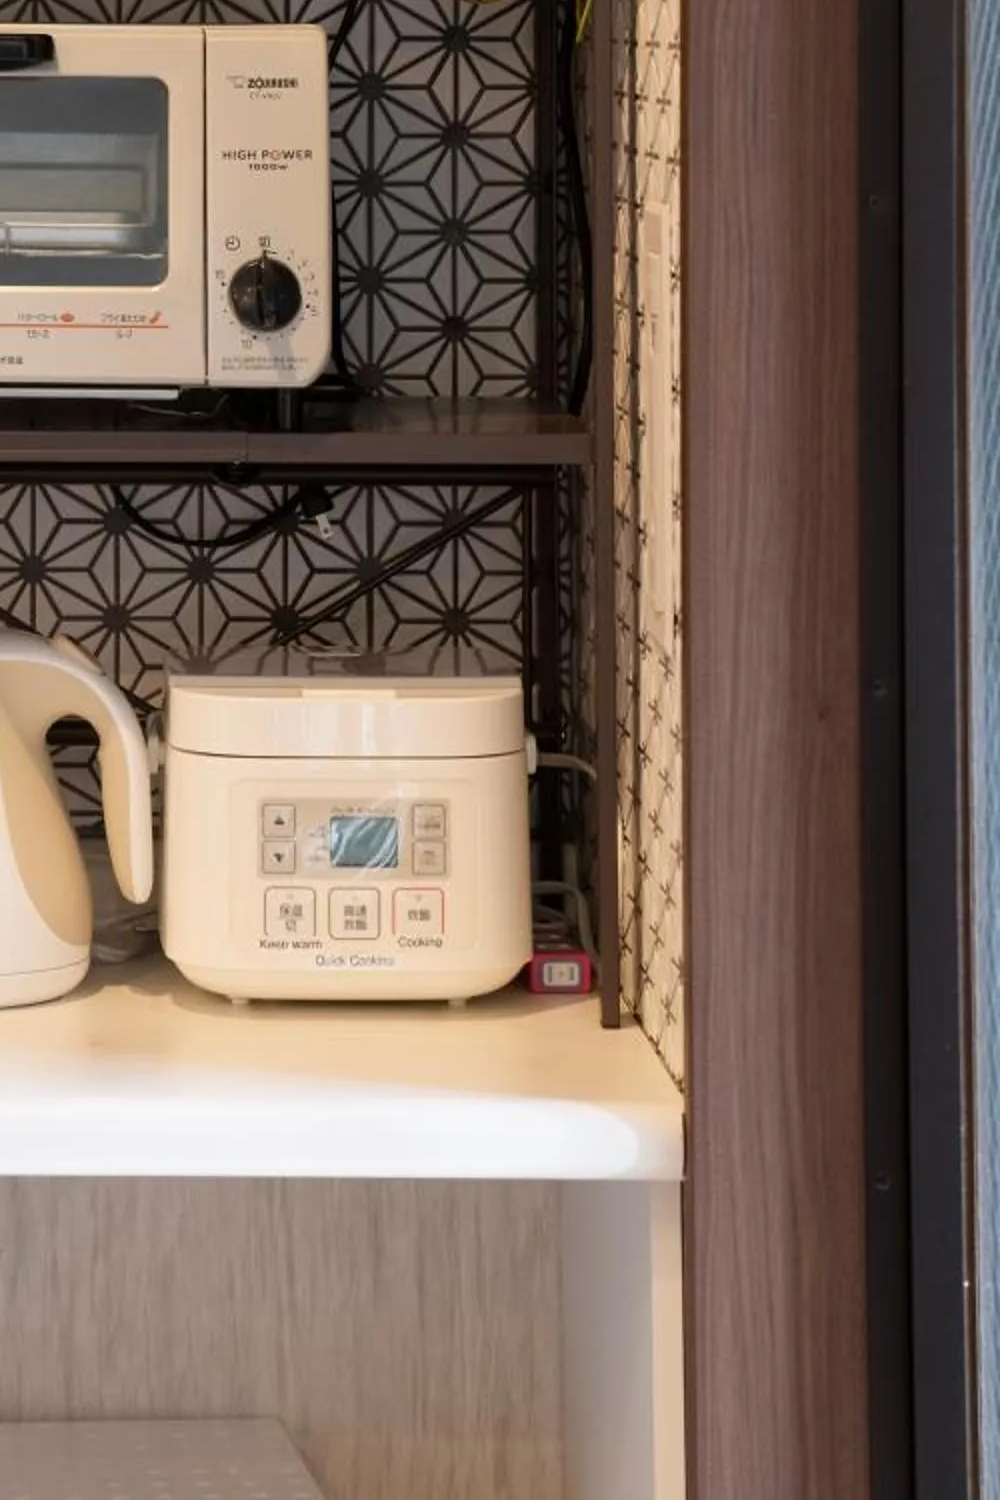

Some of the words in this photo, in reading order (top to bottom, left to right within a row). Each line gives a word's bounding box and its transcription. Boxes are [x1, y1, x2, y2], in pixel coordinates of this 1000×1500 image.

[221, 149, 257, 161] HIGH
[260, 149, 313, 161] POWER
[291, 940, 323, 950] warm
[397, 935, 443, 949] Cooking
